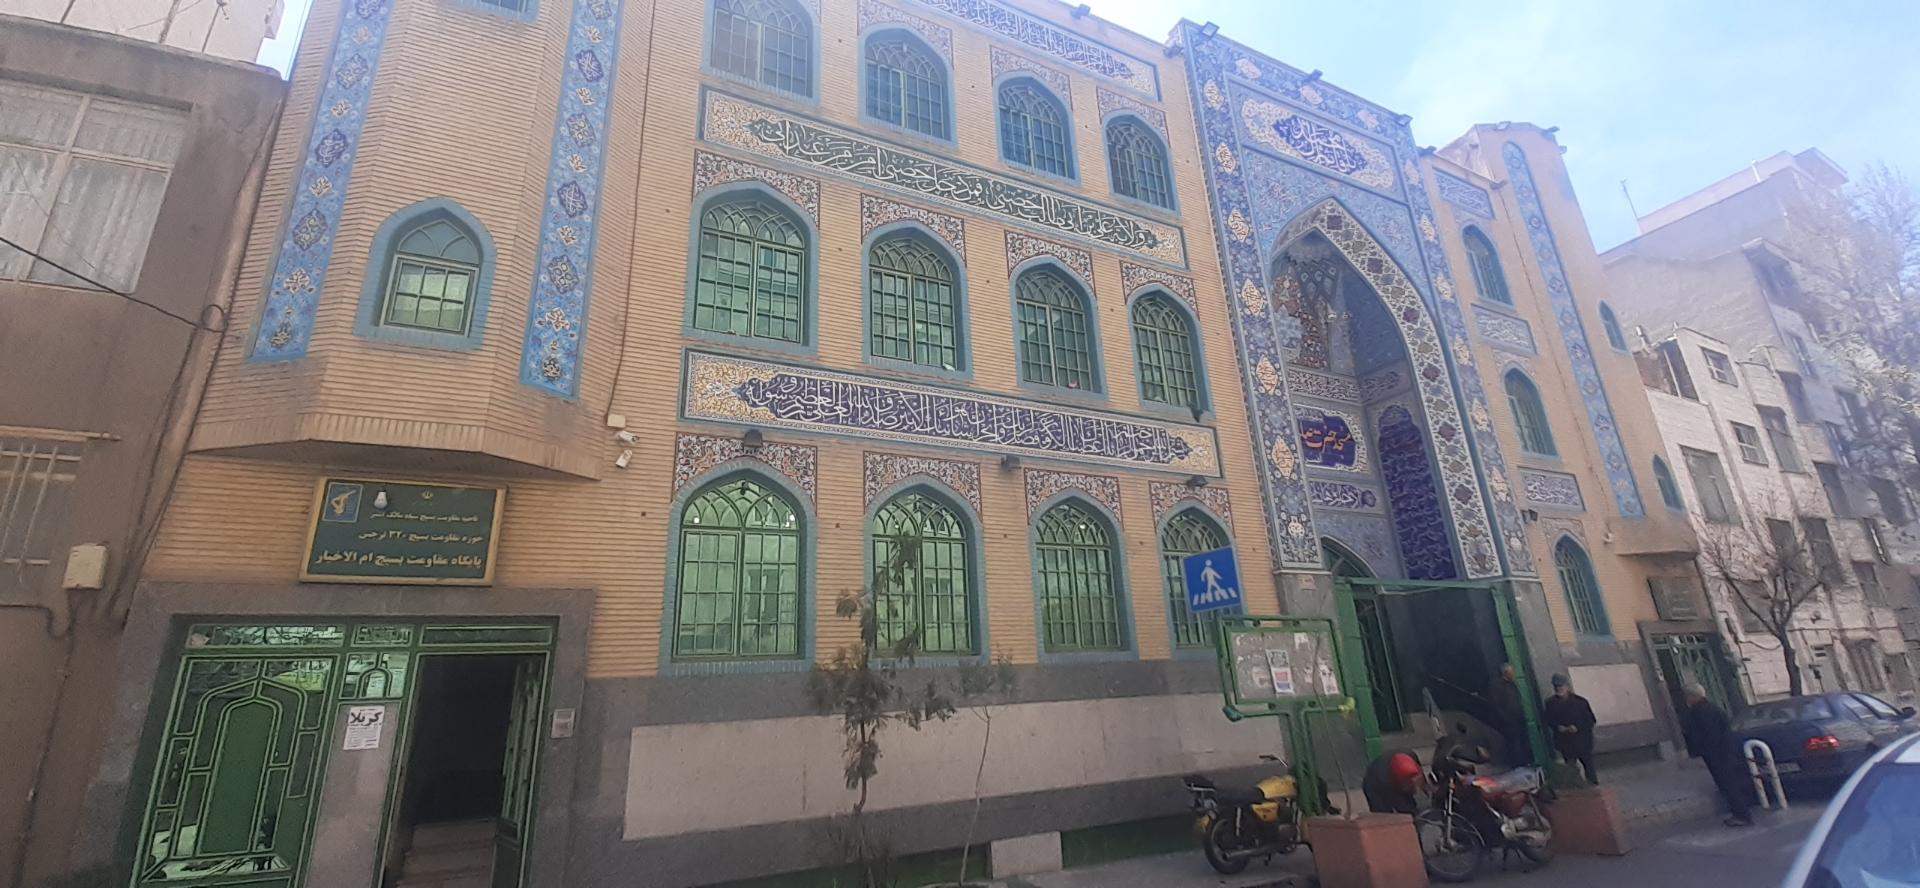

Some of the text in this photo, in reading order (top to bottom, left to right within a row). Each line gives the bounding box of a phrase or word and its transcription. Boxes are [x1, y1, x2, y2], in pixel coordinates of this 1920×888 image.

[408, 534, 430, 542] بسیج
[432, 534, 461, 543] مقاومت
[359, 552, 373, 565] ام
[375, 555, 404, 566] بسیج
[406, 554, 448, 568] مقاومت
[350, 711, 383, 726] کربلا
